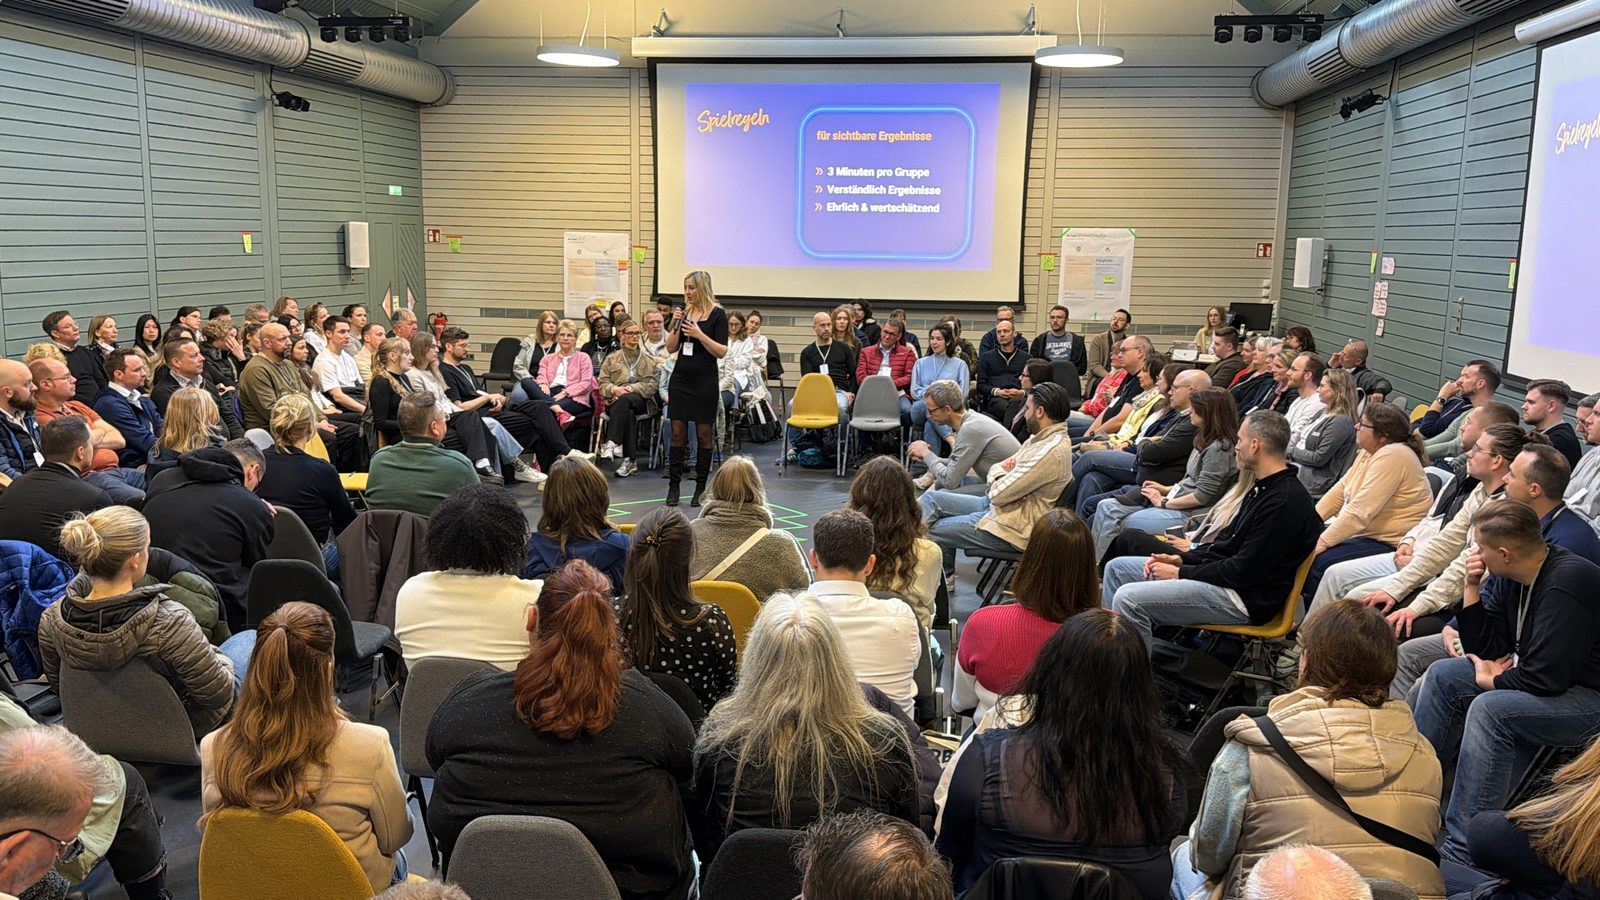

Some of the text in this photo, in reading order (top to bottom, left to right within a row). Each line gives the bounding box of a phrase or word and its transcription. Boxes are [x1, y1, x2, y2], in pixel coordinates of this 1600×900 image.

[697, 108, 771, 133] Spielregeln
[816, 131, 932, 143] für sichtbare Ergebnisse
[1555, 112, 1600, 155] Spielregel
[827, 167, 930, 179] 3 Minuten pro Gruppe
[826, 184, 942, 197] Verständlich Ergebnisse
[826, 202, 940, 213] Ehrlich & wertschätzend
